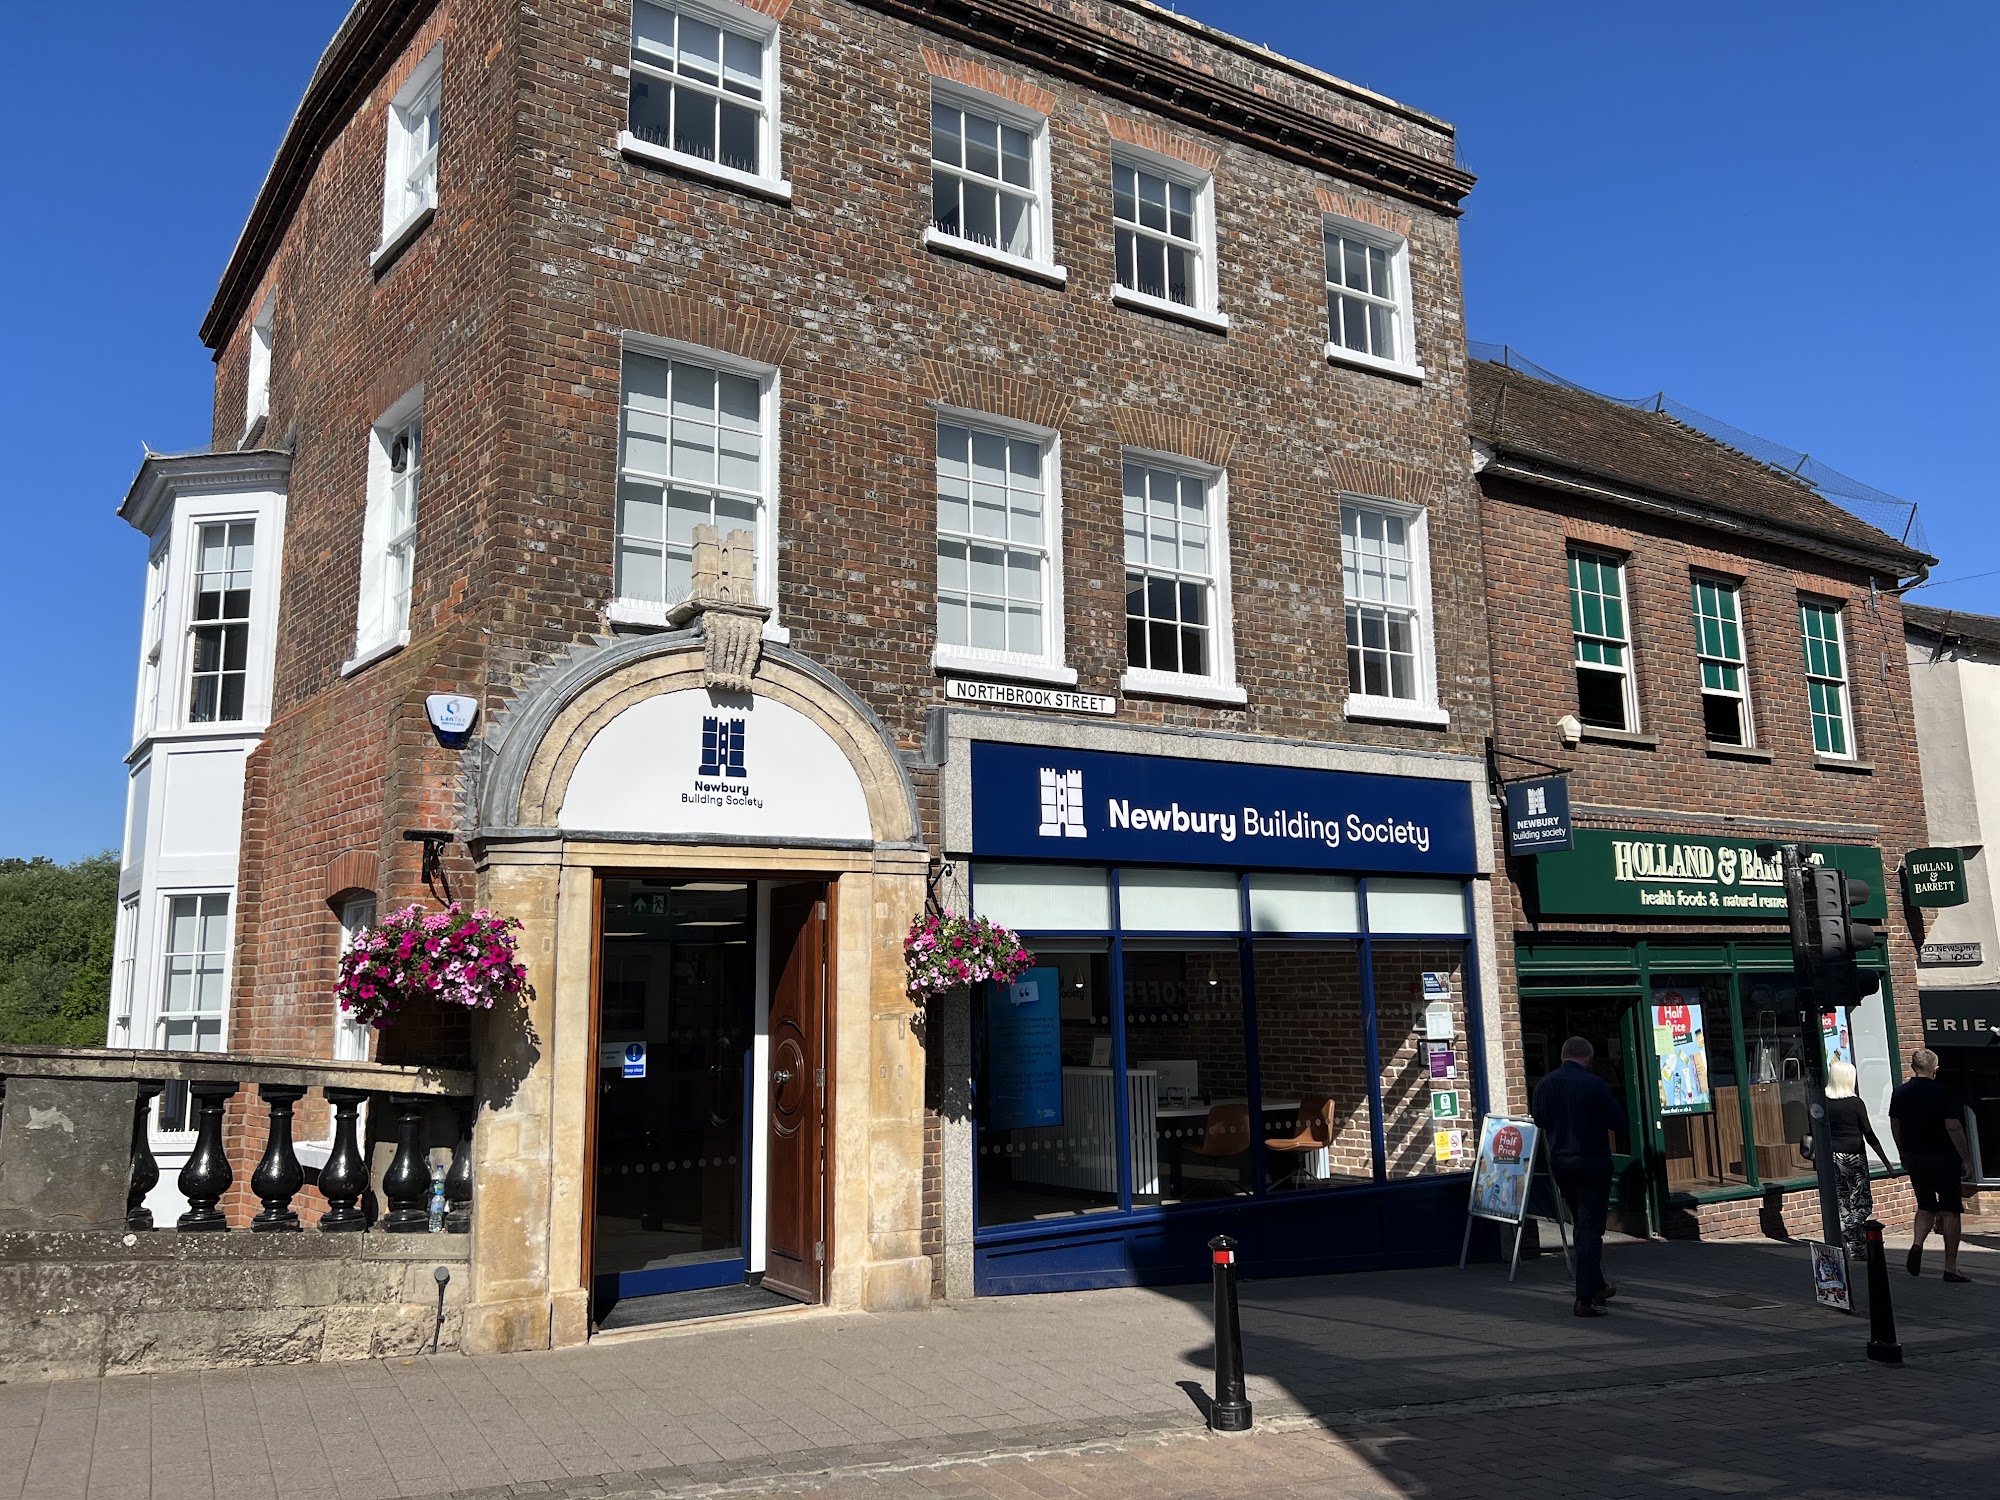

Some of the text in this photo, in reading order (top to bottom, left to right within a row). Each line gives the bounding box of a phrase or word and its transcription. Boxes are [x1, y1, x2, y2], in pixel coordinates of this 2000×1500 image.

[957, 682, 1106, 711] NORTHBROOK STREET
[440, 715, 466, 723] LanTec
[694, 780, 749, 796] Newbury
[681, 792, 764, 809] Building Society
[1108, 798, 1431, 852] Newbury Building Society
[1517, 816, 1560, 830] NEWBURY
[1512, 827, 1567, 841] building society
[1612, 841, 1715, 881] HOLLAND
[1718, 846, 1738, 885] &
[1912, 860, 1954, 875] HOLLAND
[1929, 871, 1939, 882] &
[1914, 880, 1956, 894] BARRETT
[1640, 889, 1676, 906] health
[1676, 889, 1708, 907] foods
[1709, 891, 1720, 907] &
[1722, 892, 1758, 908] natural
[1951, 953, 1975, 961] LOCK
[1061, 988, 1085, 1000] ociety
[1663, 1005, 1684, 1019] Half
[1499, 1134, 1518, 1146] Half
[1497, 1144, 1517, 1156] Price
